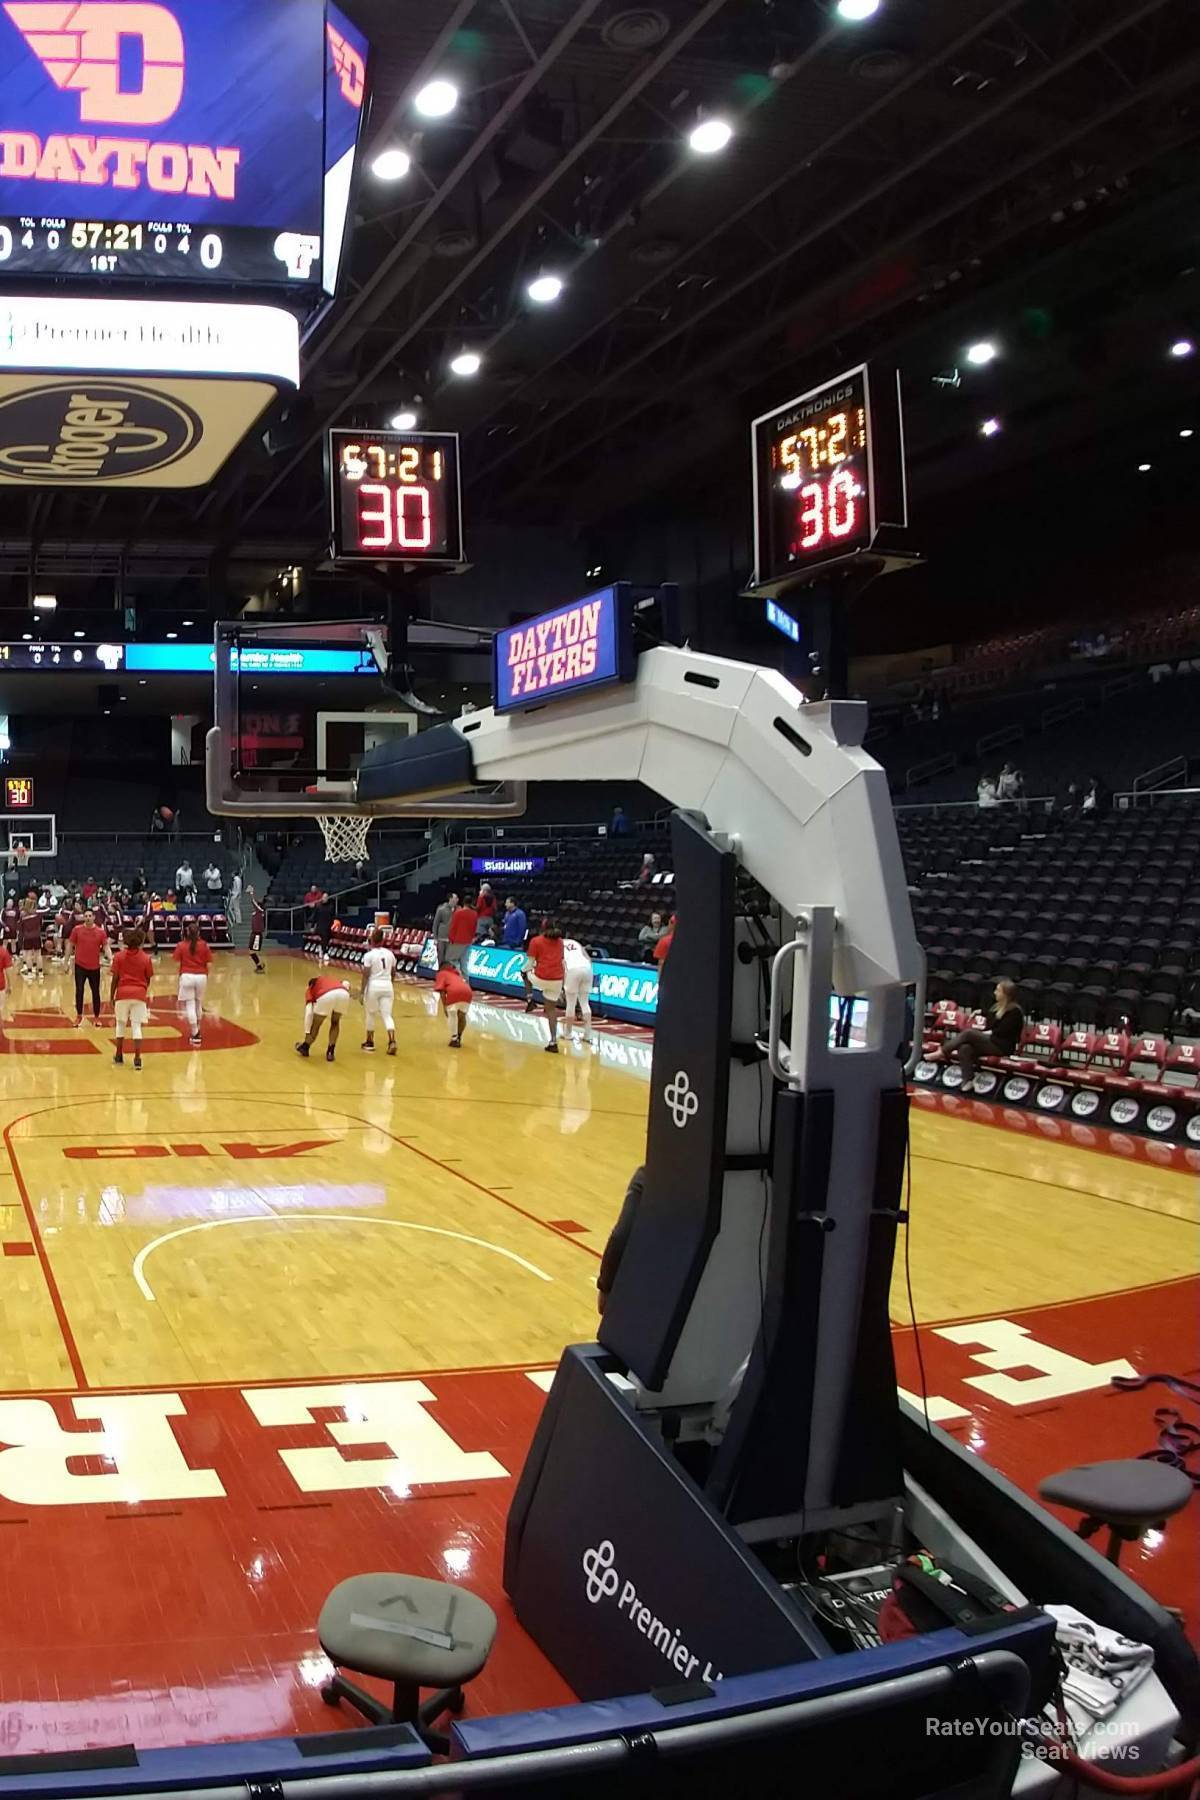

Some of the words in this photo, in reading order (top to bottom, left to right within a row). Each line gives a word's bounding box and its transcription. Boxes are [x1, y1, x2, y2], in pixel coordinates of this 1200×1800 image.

[20, 218, 36, 228] TOL
[71, 222, 143, 250] 57:21
[176, 223, 191, 233] TOL
[21, 230, 34, 250] 4
[47, 230, 60, 250] 0
[154, 234, 167, 253] 0
[177, 235, 190, 254] 4
[200, 233, 222, 269] 0
[90, 256, 117, 272] 1ST
[777, 384, 853, 431] DAKTRONICS
[781, 408, 865, 487] 57:21
[343, 445, 441, 482] 57:21
[360, 485, 431, 547] 30
[801, 469, 857, 548] 30
[508, 600, 601, 666] DAYTON
[53, 653, 60, 664] 4
[511, 638, 597, 696] FLYERS
[11, 789, 28, 804] 30
[381, 958, 386, 969] 1
[629, 979, 660, 1004] LIV
[618, 1580, 699, 1679] Premier
